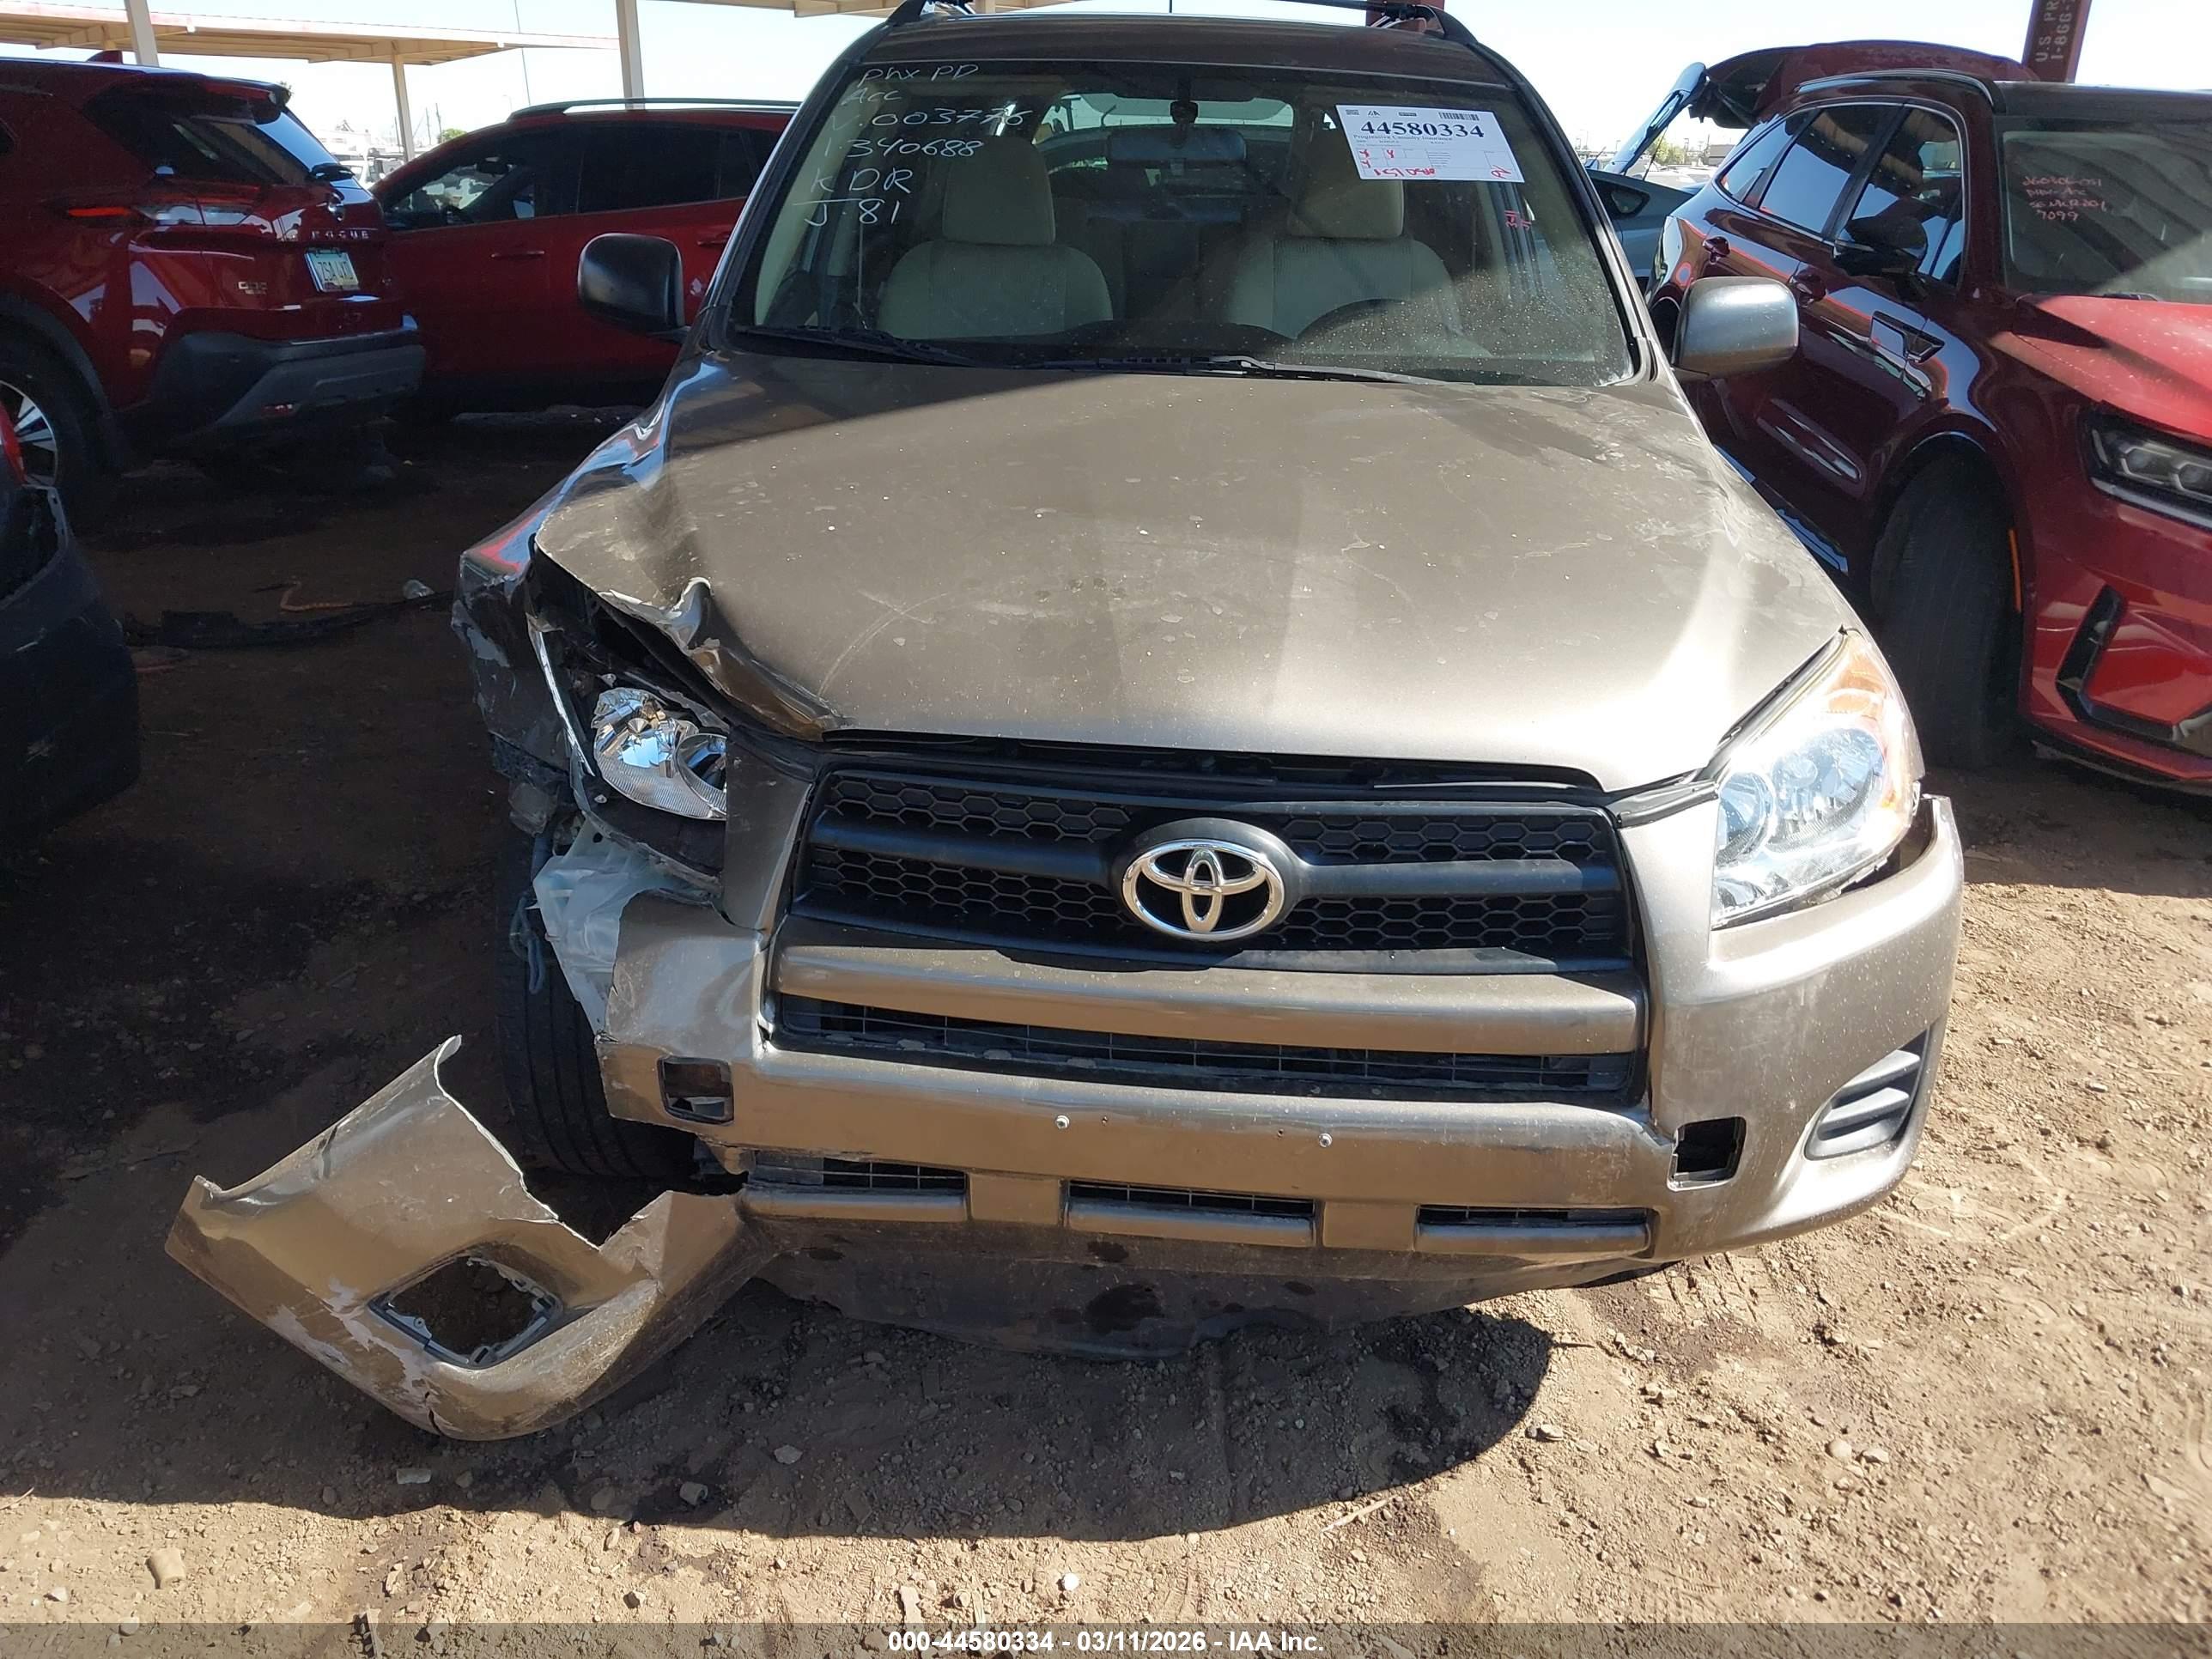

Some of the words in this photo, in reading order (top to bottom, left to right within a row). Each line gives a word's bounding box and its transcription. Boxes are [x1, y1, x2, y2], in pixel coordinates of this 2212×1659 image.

[931, 64, 979, 82] PD
[1360, 120, 1485, 138] 44580334
[2036, 210, 2079, 222] 7099
